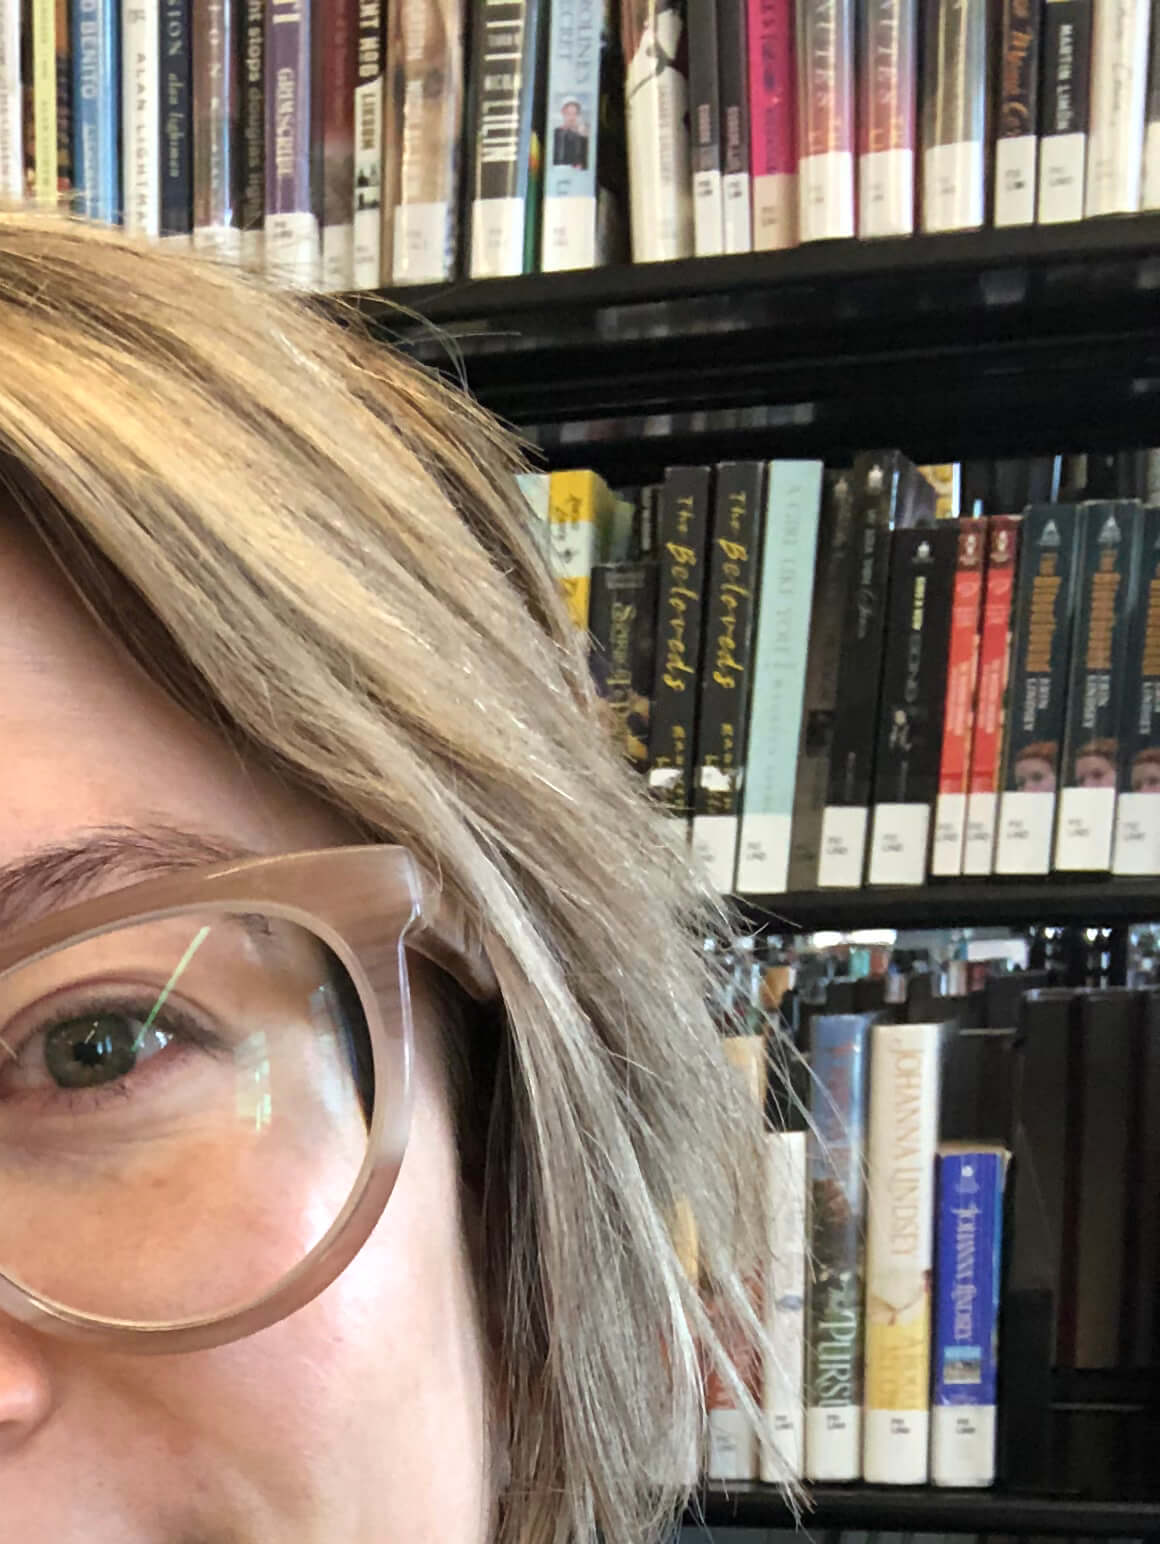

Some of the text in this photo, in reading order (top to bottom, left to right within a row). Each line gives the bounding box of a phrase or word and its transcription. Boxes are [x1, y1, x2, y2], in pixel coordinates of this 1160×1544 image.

[80, 21, 98, 100] BENITO
[246, 27, 262, 82] stops
[1058, 24, 1073, 81] MARTIN
[135, 53, 147, 230] ALAN LIGHTMA
[663, 541, 700, 692] Beloveds
[712, 537, 751, 690] Beloveds
[889, 1040, 924, 1257] JOHANNA LINDSEY
[815, 1312, 857, 1407] PURSU
